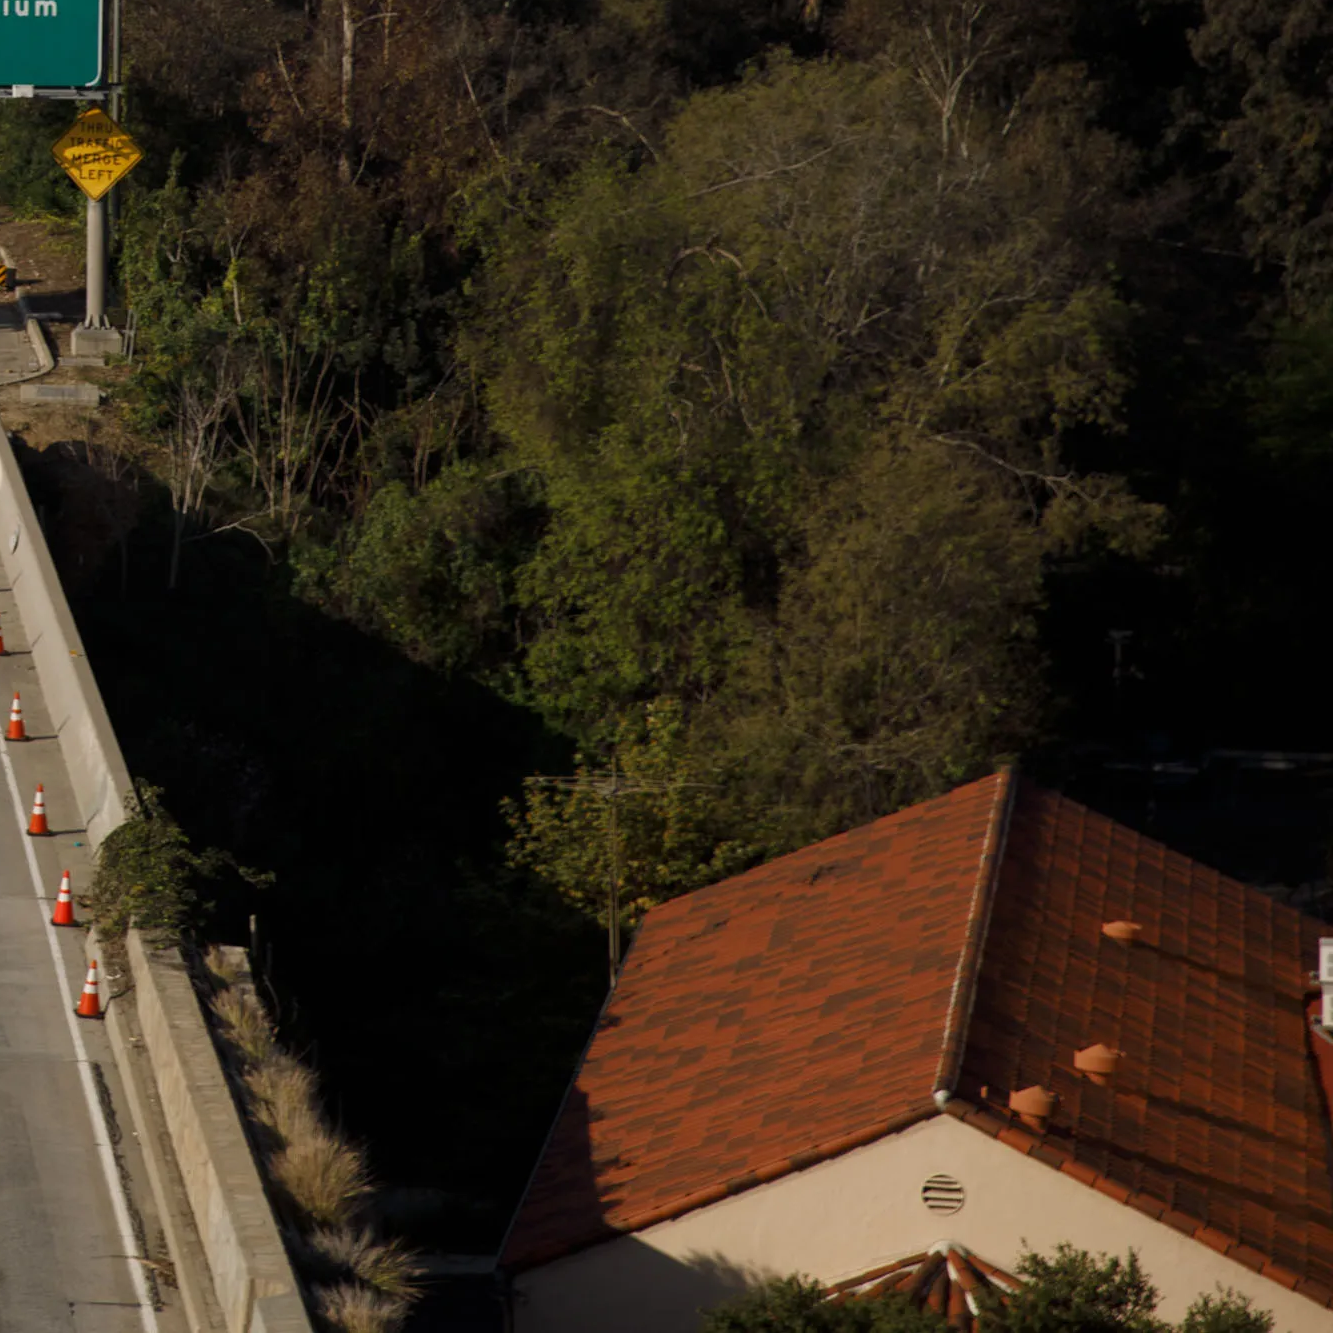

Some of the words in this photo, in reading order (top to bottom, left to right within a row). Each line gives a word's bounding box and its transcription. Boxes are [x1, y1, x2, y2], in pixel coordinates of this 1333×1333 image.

[80, 122, 113, 134] THRU
[70, 136, 122, 150] TRAFFIC
[73, 153, 122, 166] MERGE
[79, 169, 114, 181] LEFT
